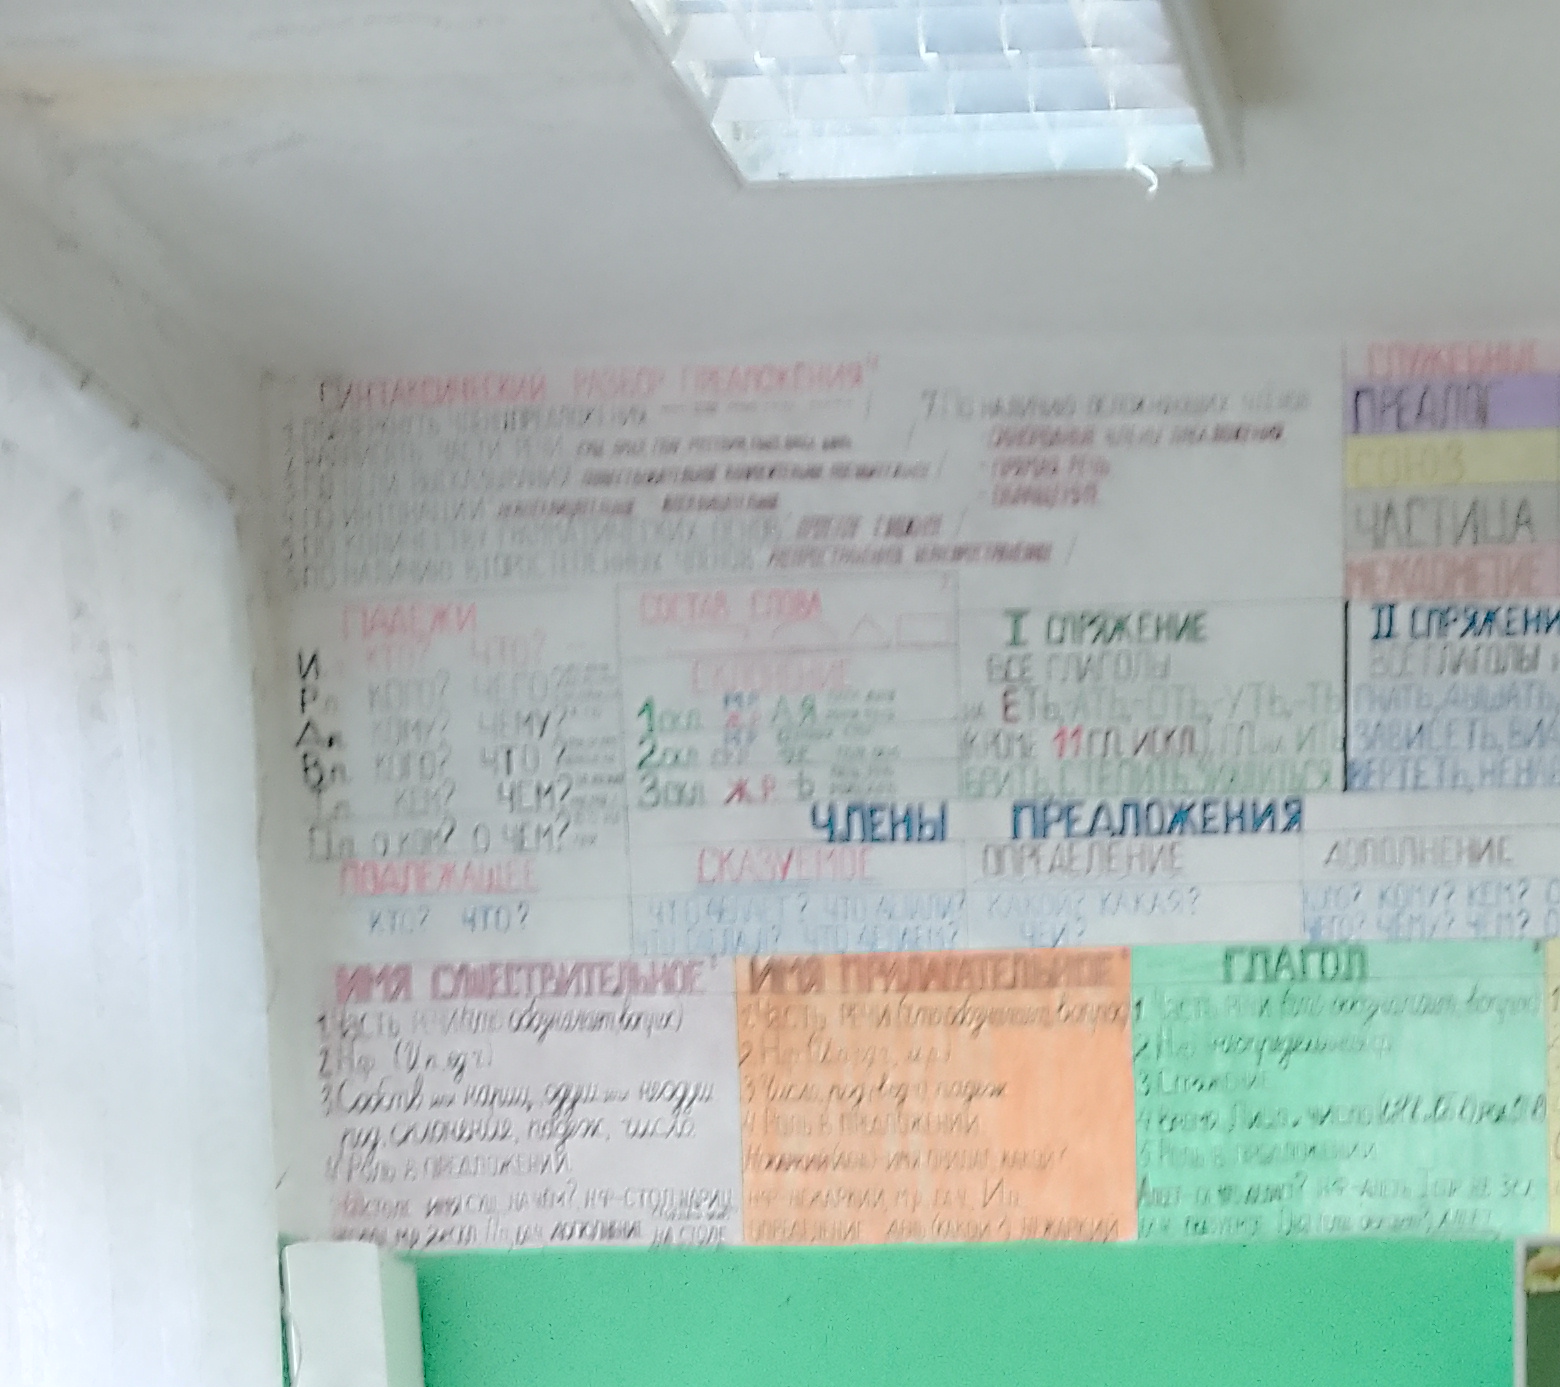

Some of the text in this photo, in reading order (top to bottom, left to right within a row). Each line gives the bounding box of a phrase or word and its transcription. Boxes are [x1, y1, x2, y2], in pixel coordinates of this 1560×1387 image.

[1044, 609, 1208, 645] СПРЯЖЕНИЕ
[809, 796, 1306, 843] ЧЛЕНЫ ПРЕДЛОЖЕНИЯ
[981, 842, 1185, 878] ОПРЕДЕЛЕНИЕ
[334, 962, 412, 1003] ИМЯ
[750, 954, 826, 995] ИМЯ
[1222, 944, 1369, 984] ГЛАГОЛ
